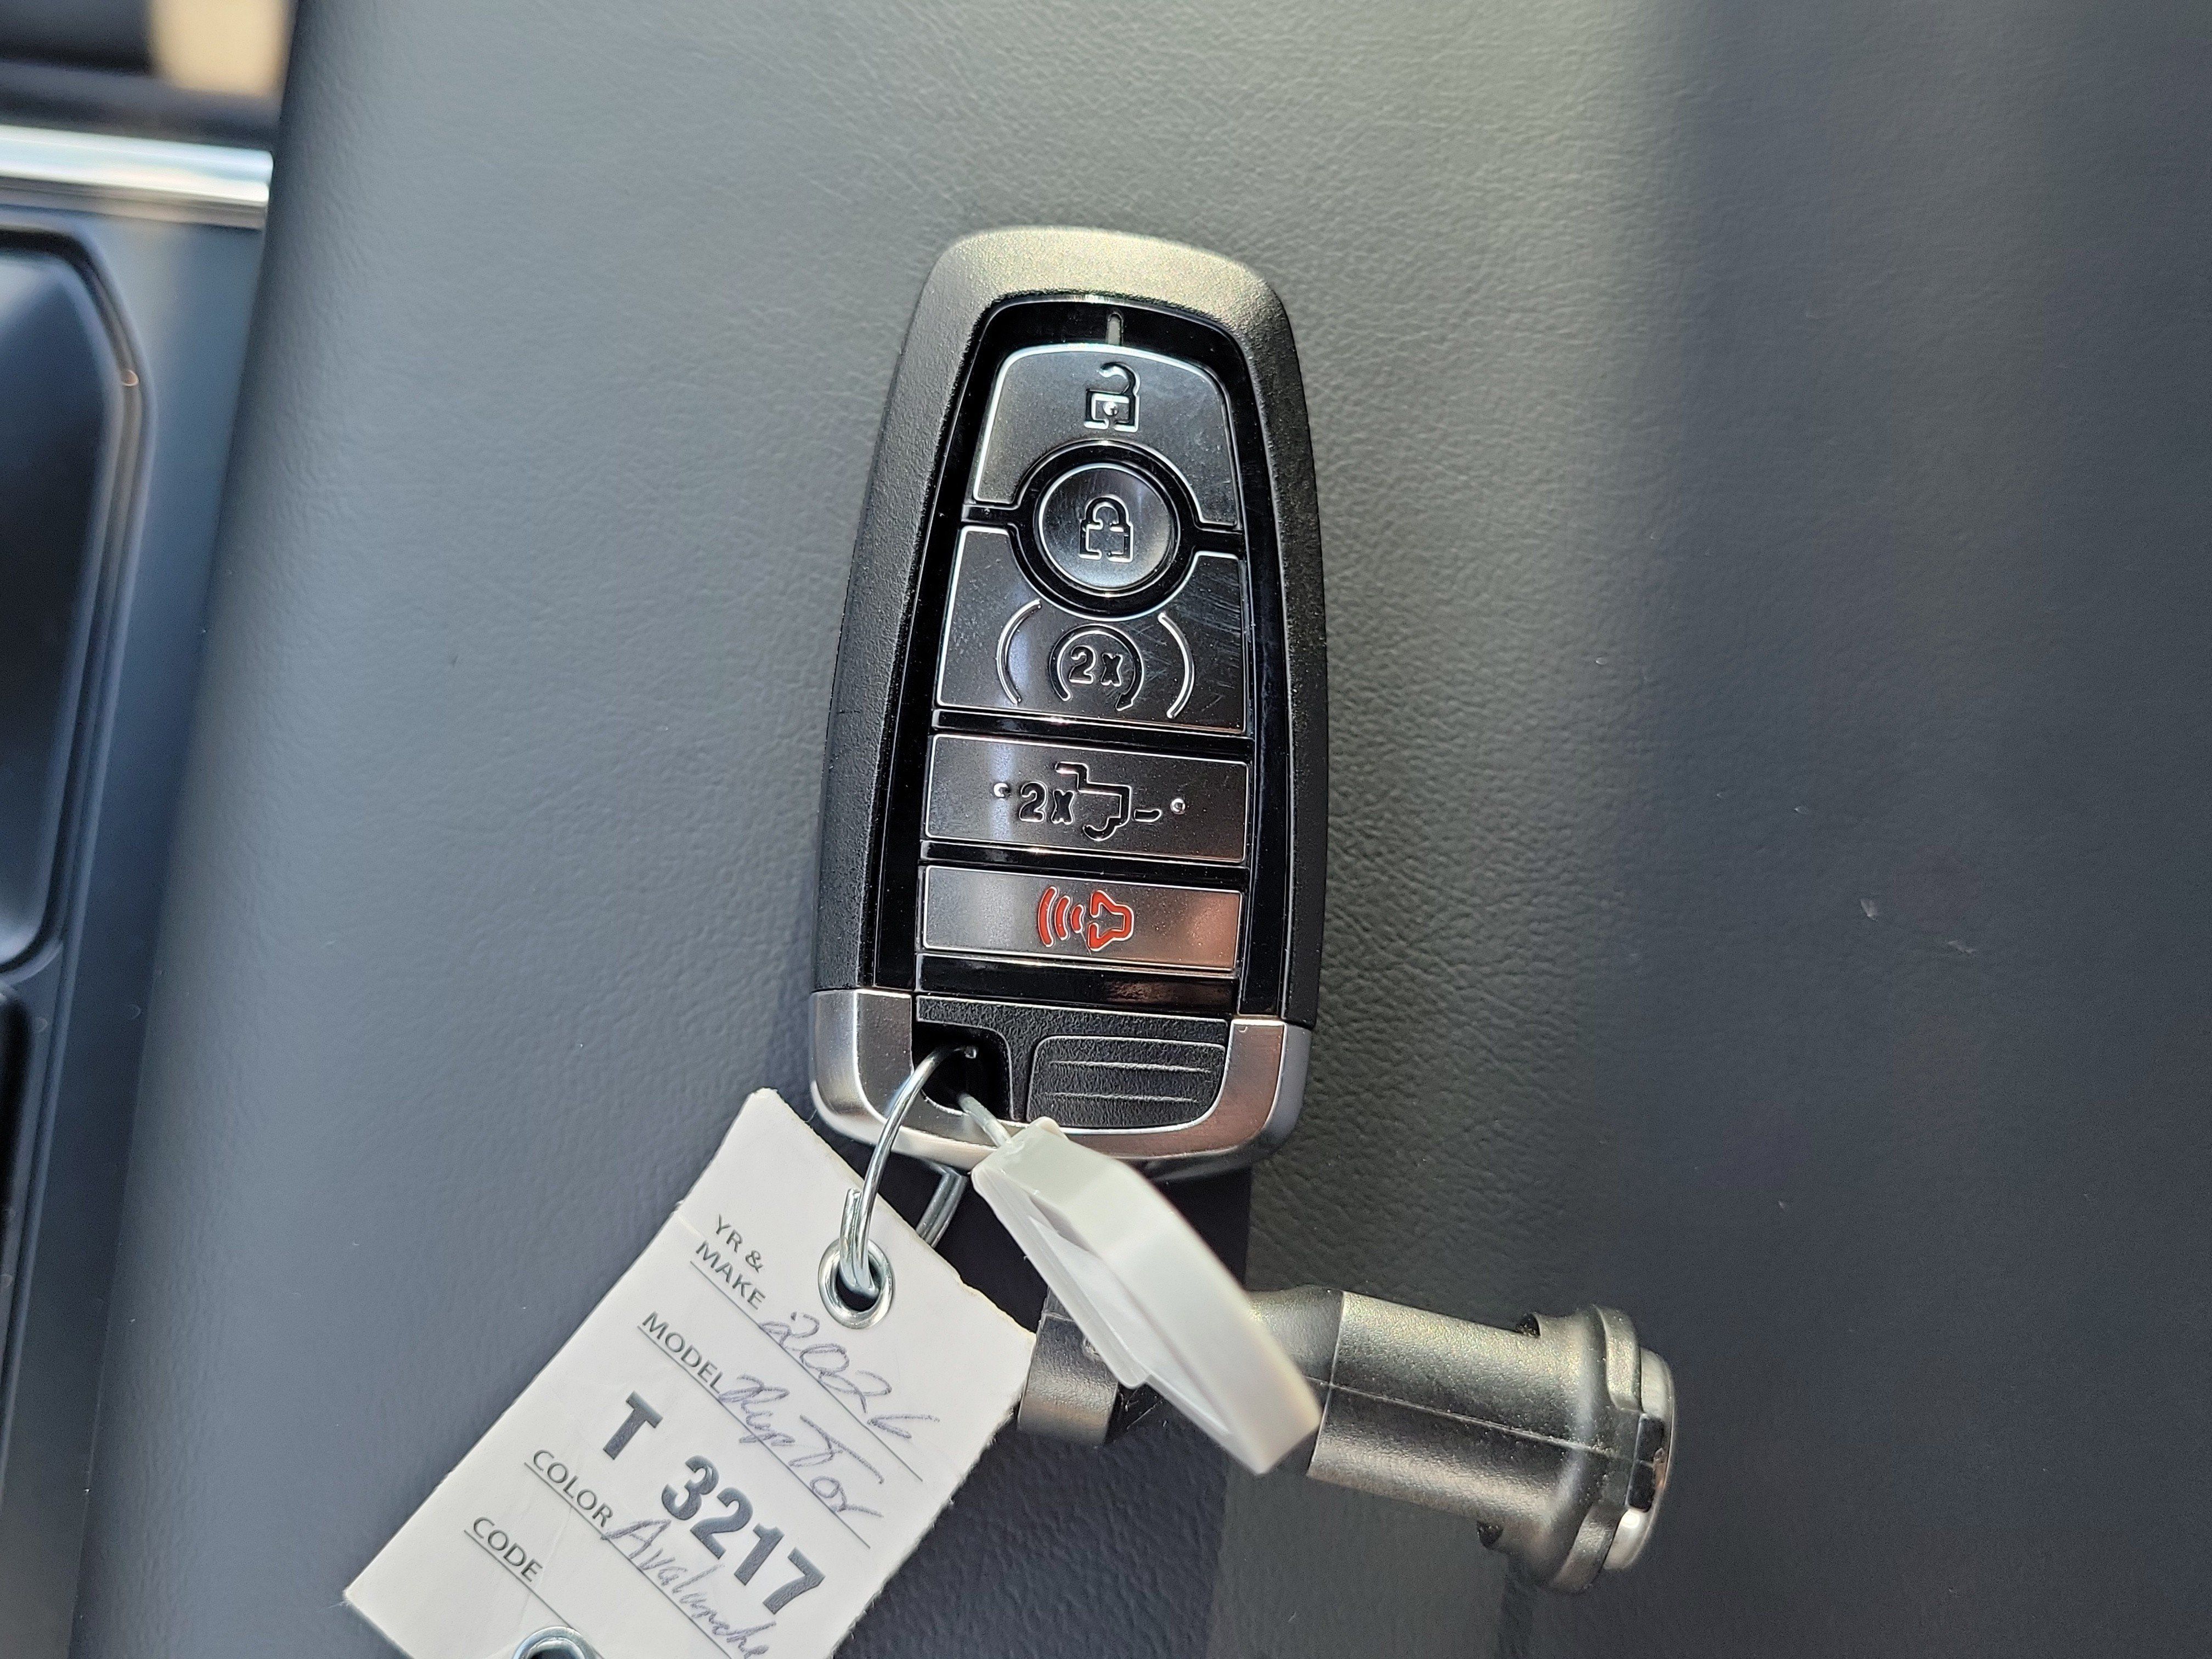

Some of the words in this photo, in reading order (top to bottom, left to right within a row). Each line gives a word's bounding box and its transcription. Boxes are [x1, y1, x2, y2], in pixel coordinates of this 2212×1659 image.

[1068, 645, 1122, 686] 2x
[1019, 781, 1075, 824] 2x
[696, 1240, 766, 1310] MAKE
[716, 1214, 743, 1253] YR
[745, 1250, 763, 1273] &
[642, 1311, 723, 1394] MODEL
[533, 1449, 613, 1527] COLOR
[603, 1391, 663, 1460] T
[661, 1454, 826, 1615] 3217
[473, 1516, 543, 1582] CODE
